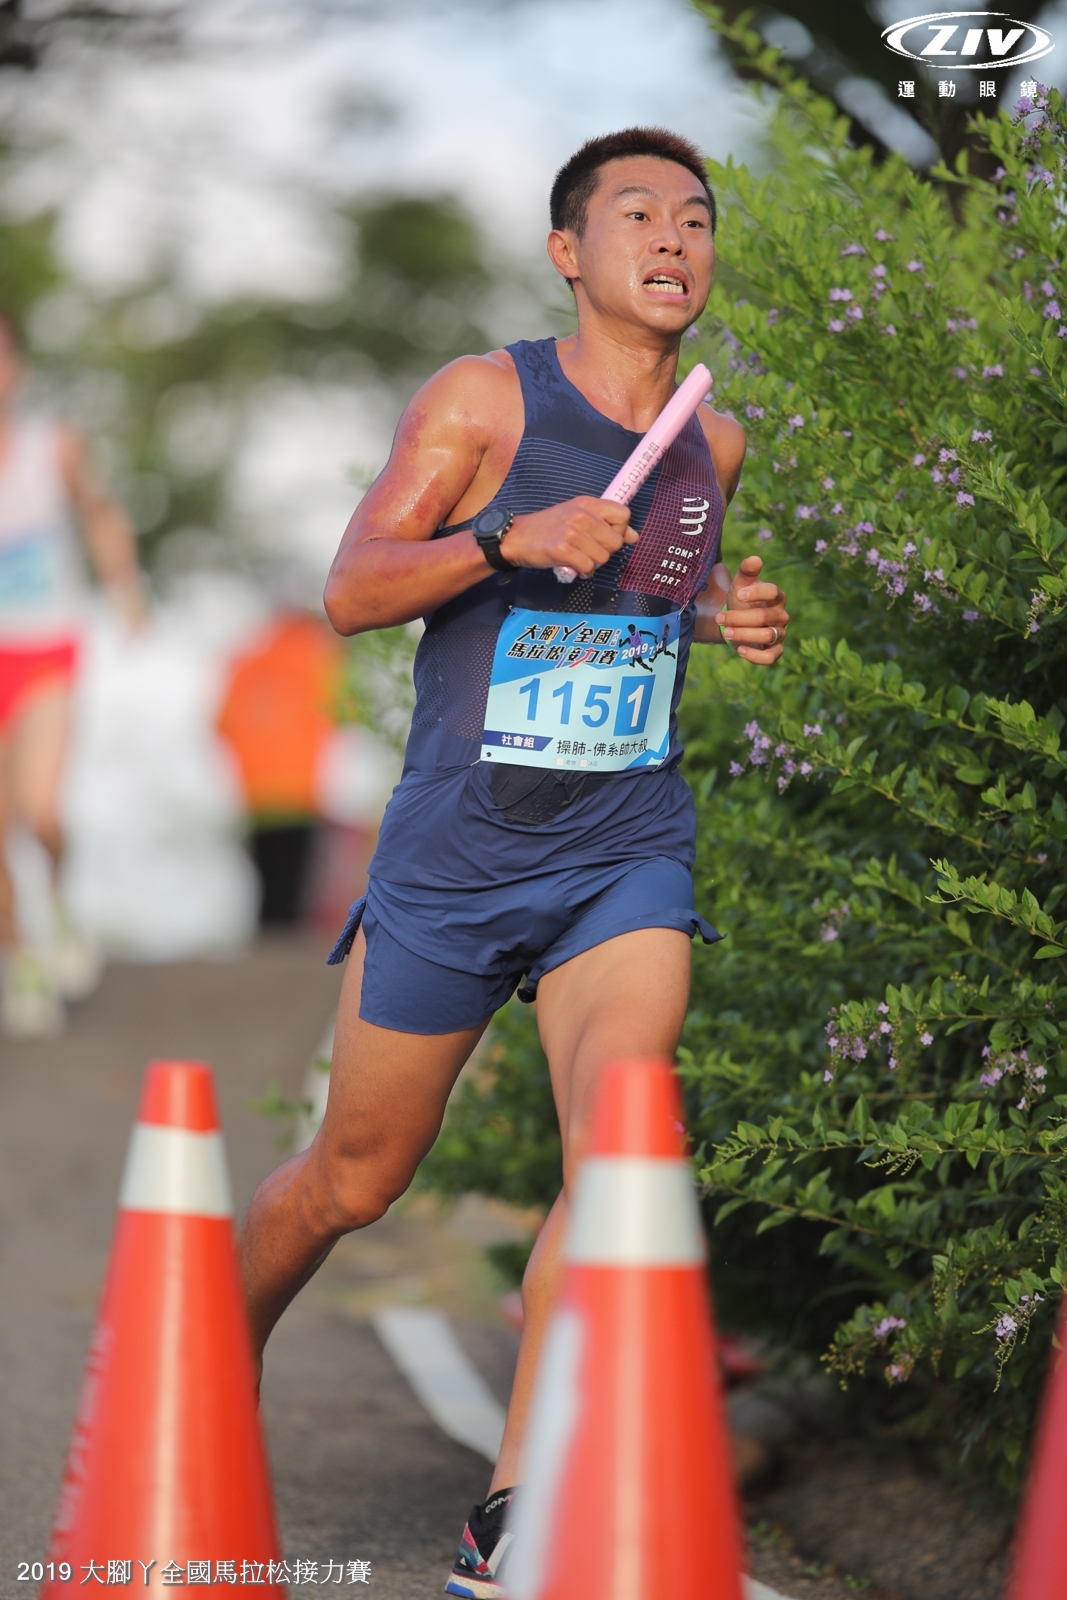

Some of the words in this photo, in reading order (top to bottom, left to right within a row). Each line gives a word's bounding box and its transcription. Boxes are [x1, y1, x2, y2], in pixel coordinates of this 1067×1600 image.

[660, 559, 689, 574] RESS
[652, 573, 682, 587] PORT
[506, 641, 621, 669] 馬拉松接力賽
[620, 642, 649, 661] 2019
[519, 677, 646, 728] 1151
[501, 733, 536, 749] 社會組
